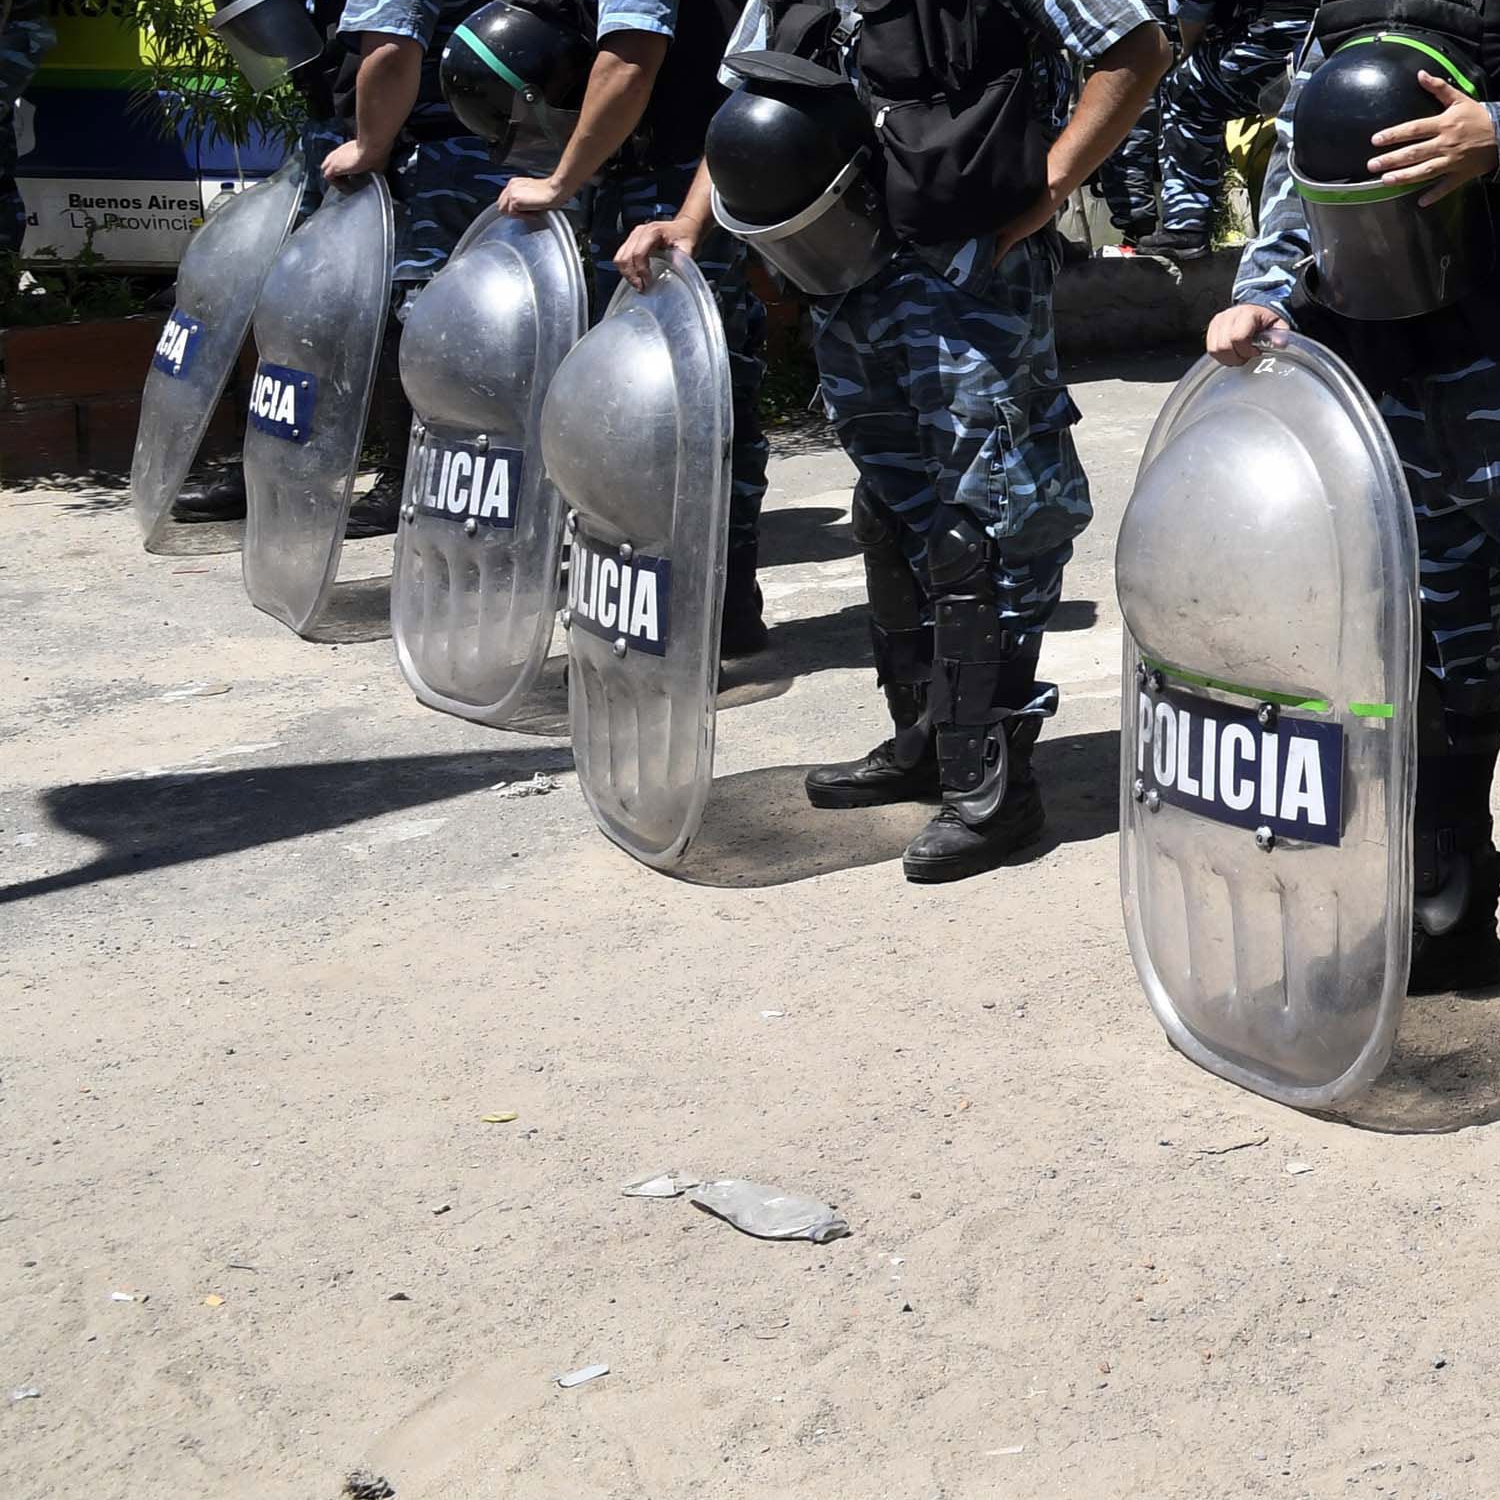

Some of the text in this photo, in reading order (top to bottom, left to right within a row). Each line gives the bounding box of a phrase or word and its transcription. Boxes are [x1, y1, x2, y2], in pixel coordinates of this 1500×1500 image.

[69, 193, 199, 211] Buenos Aires
[70, 212, 97, 229] La
[1137, 691, 1328, 826] POLICIA
